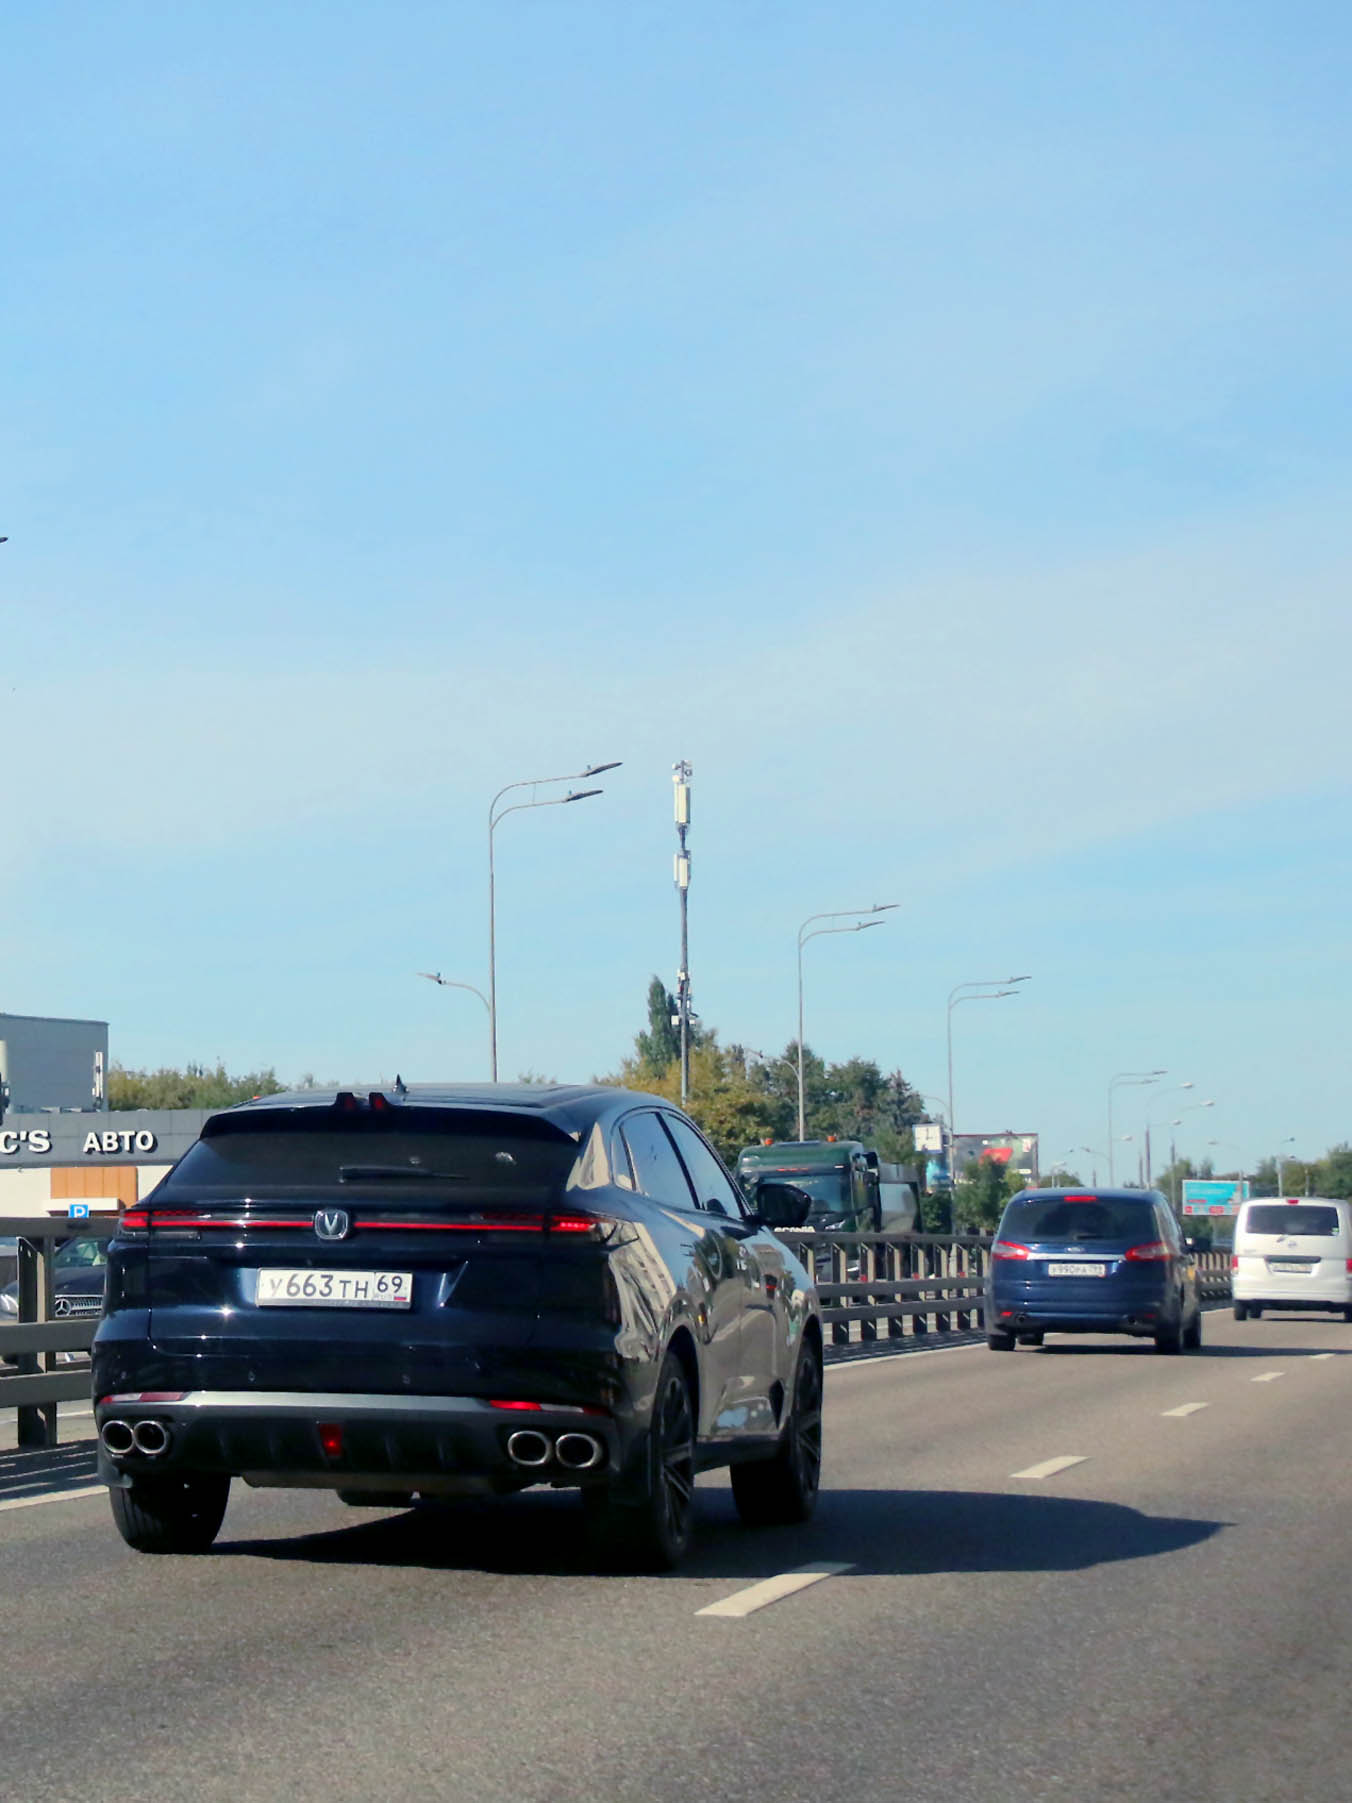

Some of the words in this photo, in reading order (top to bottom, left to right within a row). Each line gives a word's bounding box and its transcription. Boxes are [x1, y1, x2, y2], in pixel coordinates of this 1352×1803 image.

[82, 1130, 154, 1153] АВТО
[270, 1273, 369, 1299] У663ТН
[377, 1275, 403, 1293] 69
